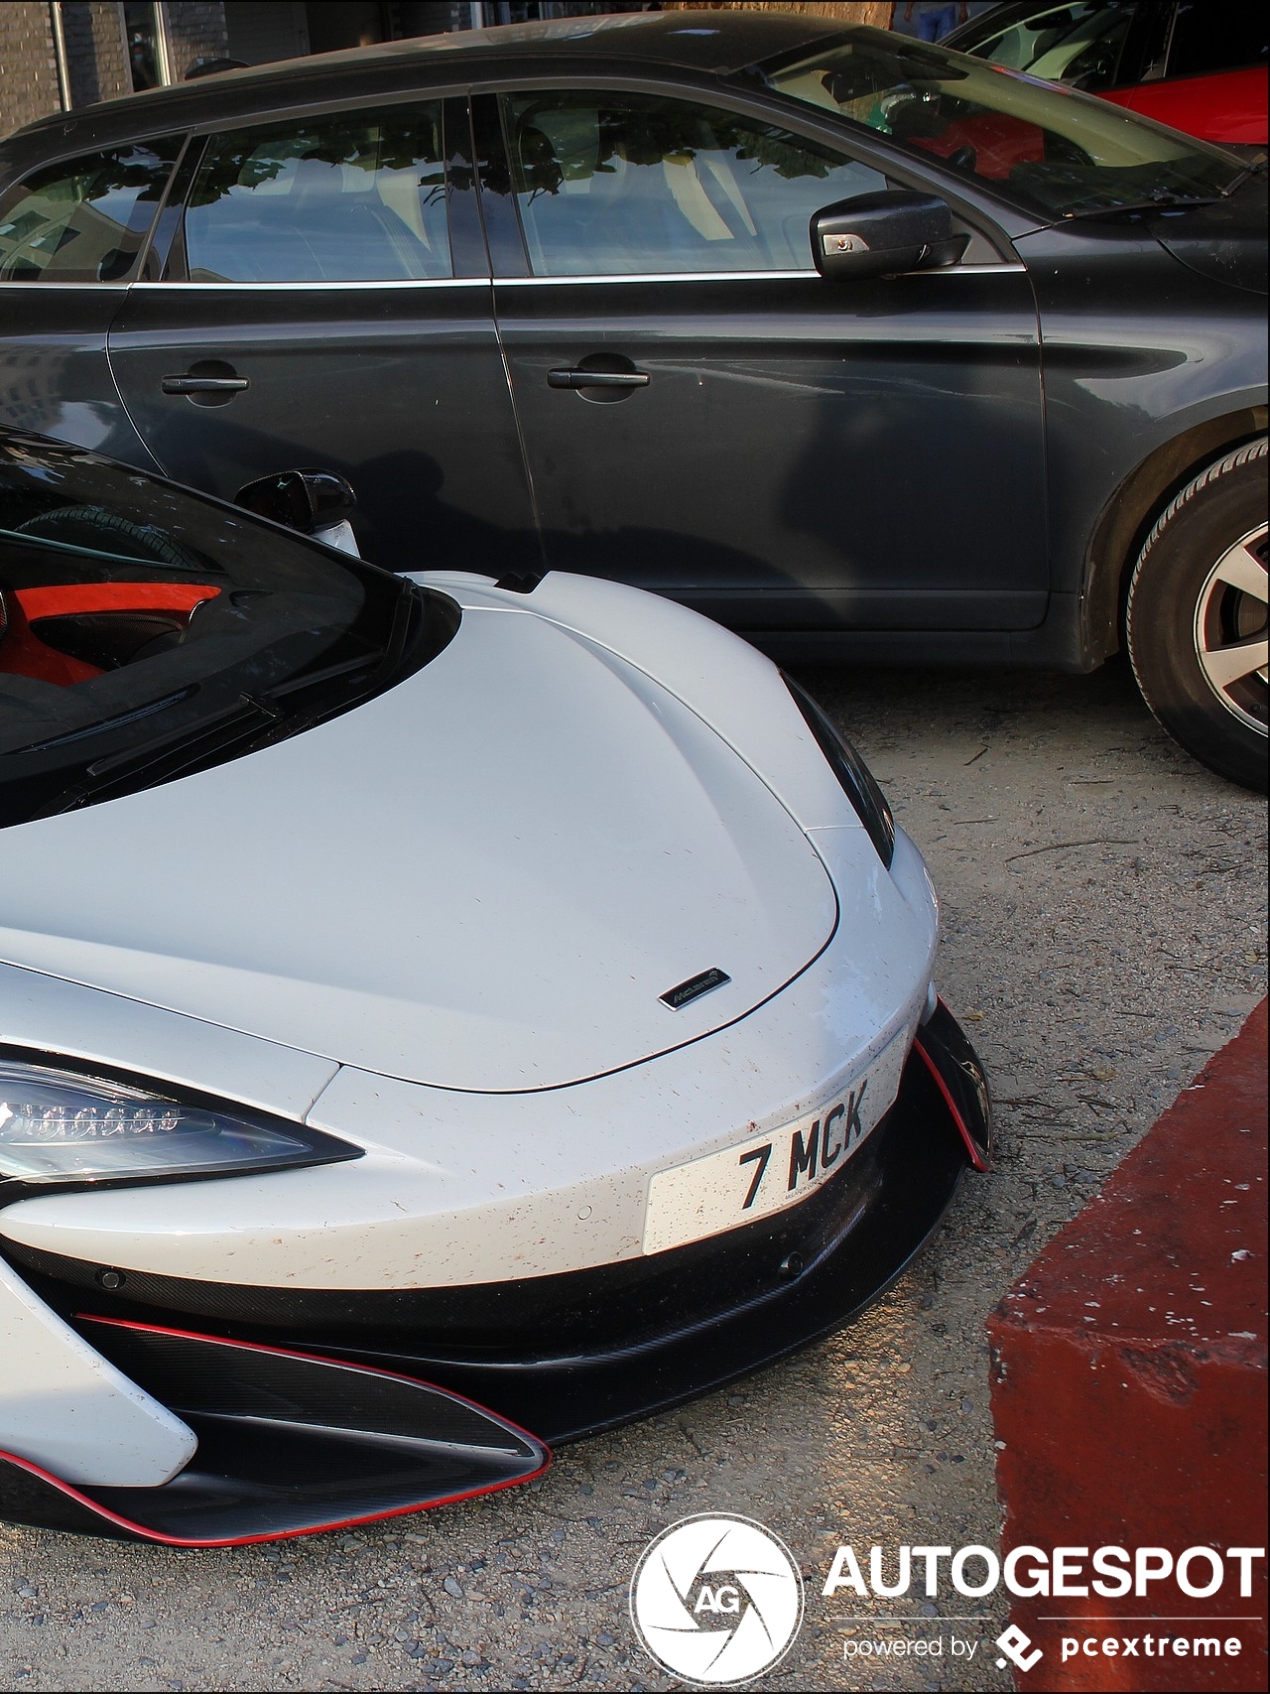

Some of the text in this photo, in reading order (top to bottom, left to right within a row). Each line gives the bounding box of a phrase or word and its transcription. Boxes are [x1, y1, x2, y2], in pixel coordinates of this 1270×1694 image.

[673, 976, 719, 1003] McLaren
[739, 1079, 868, 1210] 7 MCK
